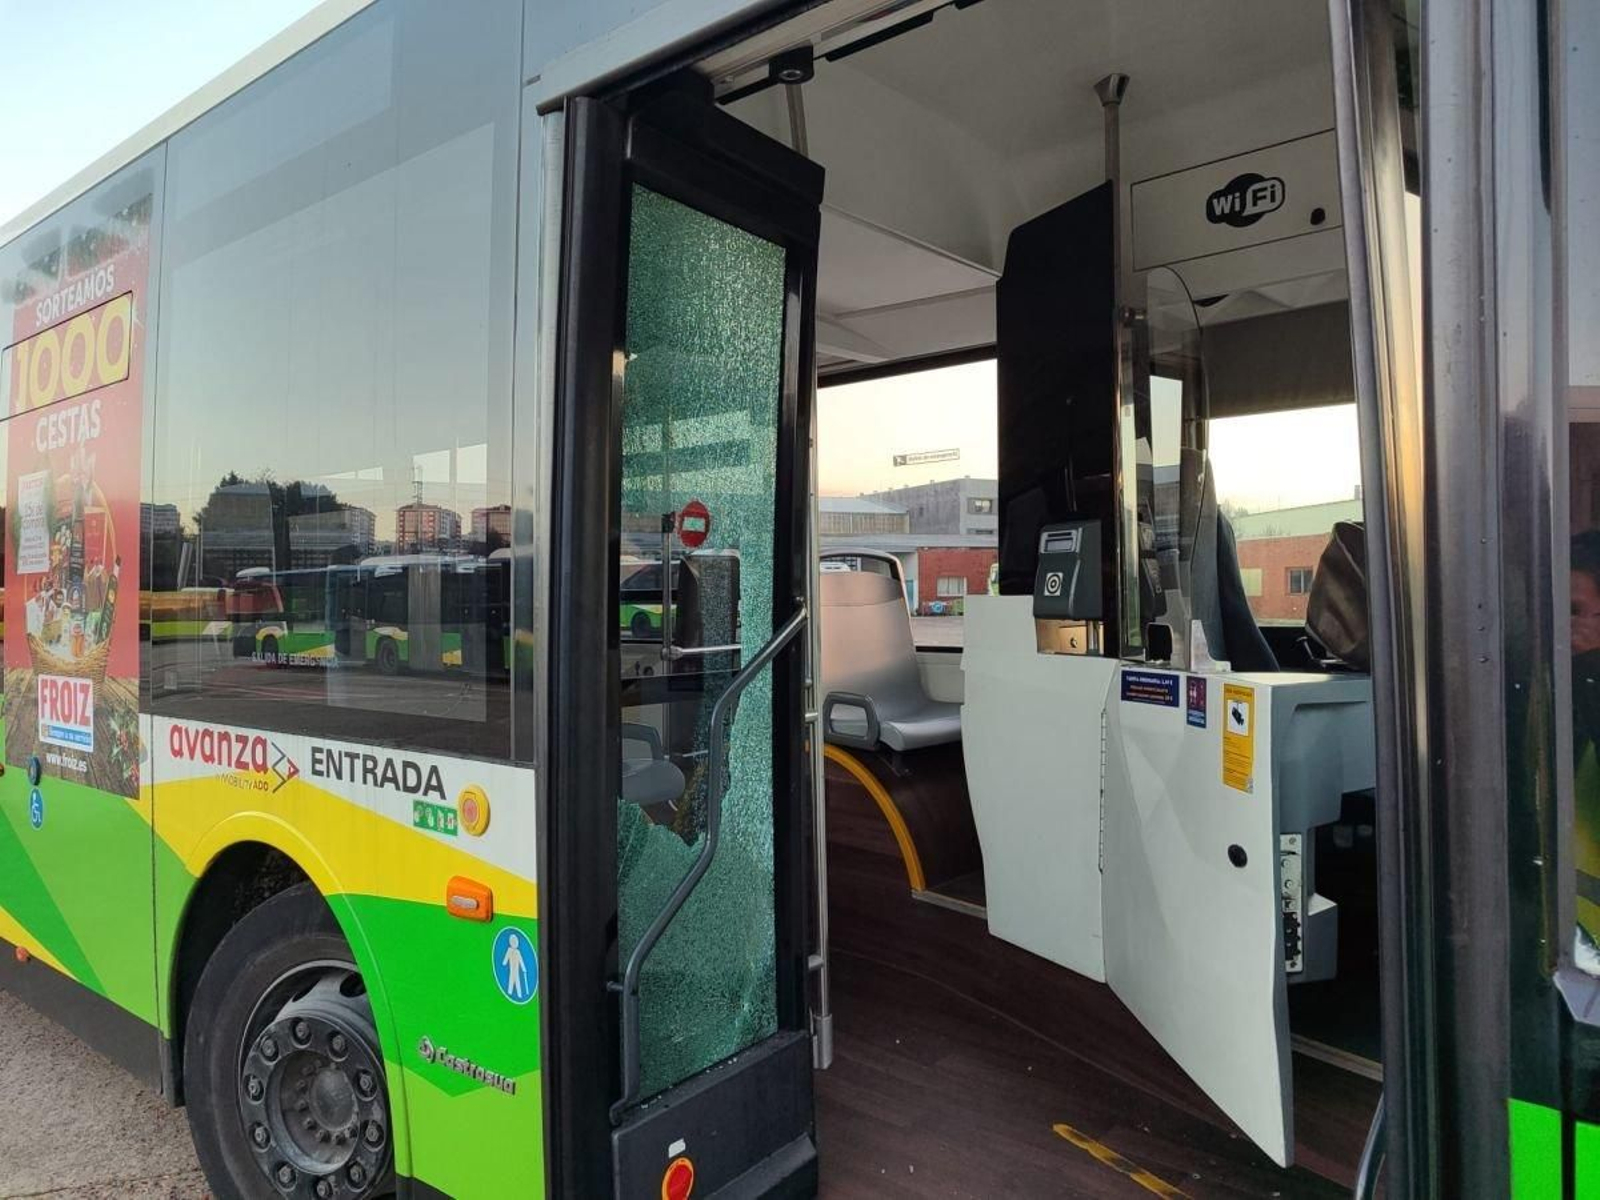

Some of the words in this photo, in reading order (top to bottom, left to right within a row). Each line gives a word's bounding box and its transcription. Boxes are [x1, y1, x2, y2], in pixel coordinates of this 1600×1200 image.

[1212, 184, 1277, 216] WiFi
[35, 264, 115, 326] SORTEAMOS
[15, 296, 133, 415] 1000
[35, 399, 101, 451] CESTAS
[251, 651, 277, 665] SALIDA
[278, 652, 289, 665] DE
[41, 678, 91, 727] FROIZ
[46, 752, 88, 773] www.froiz.es
[170, 724, 269, 775] avanza
[311, 746, 447, 800] ENTRADA
